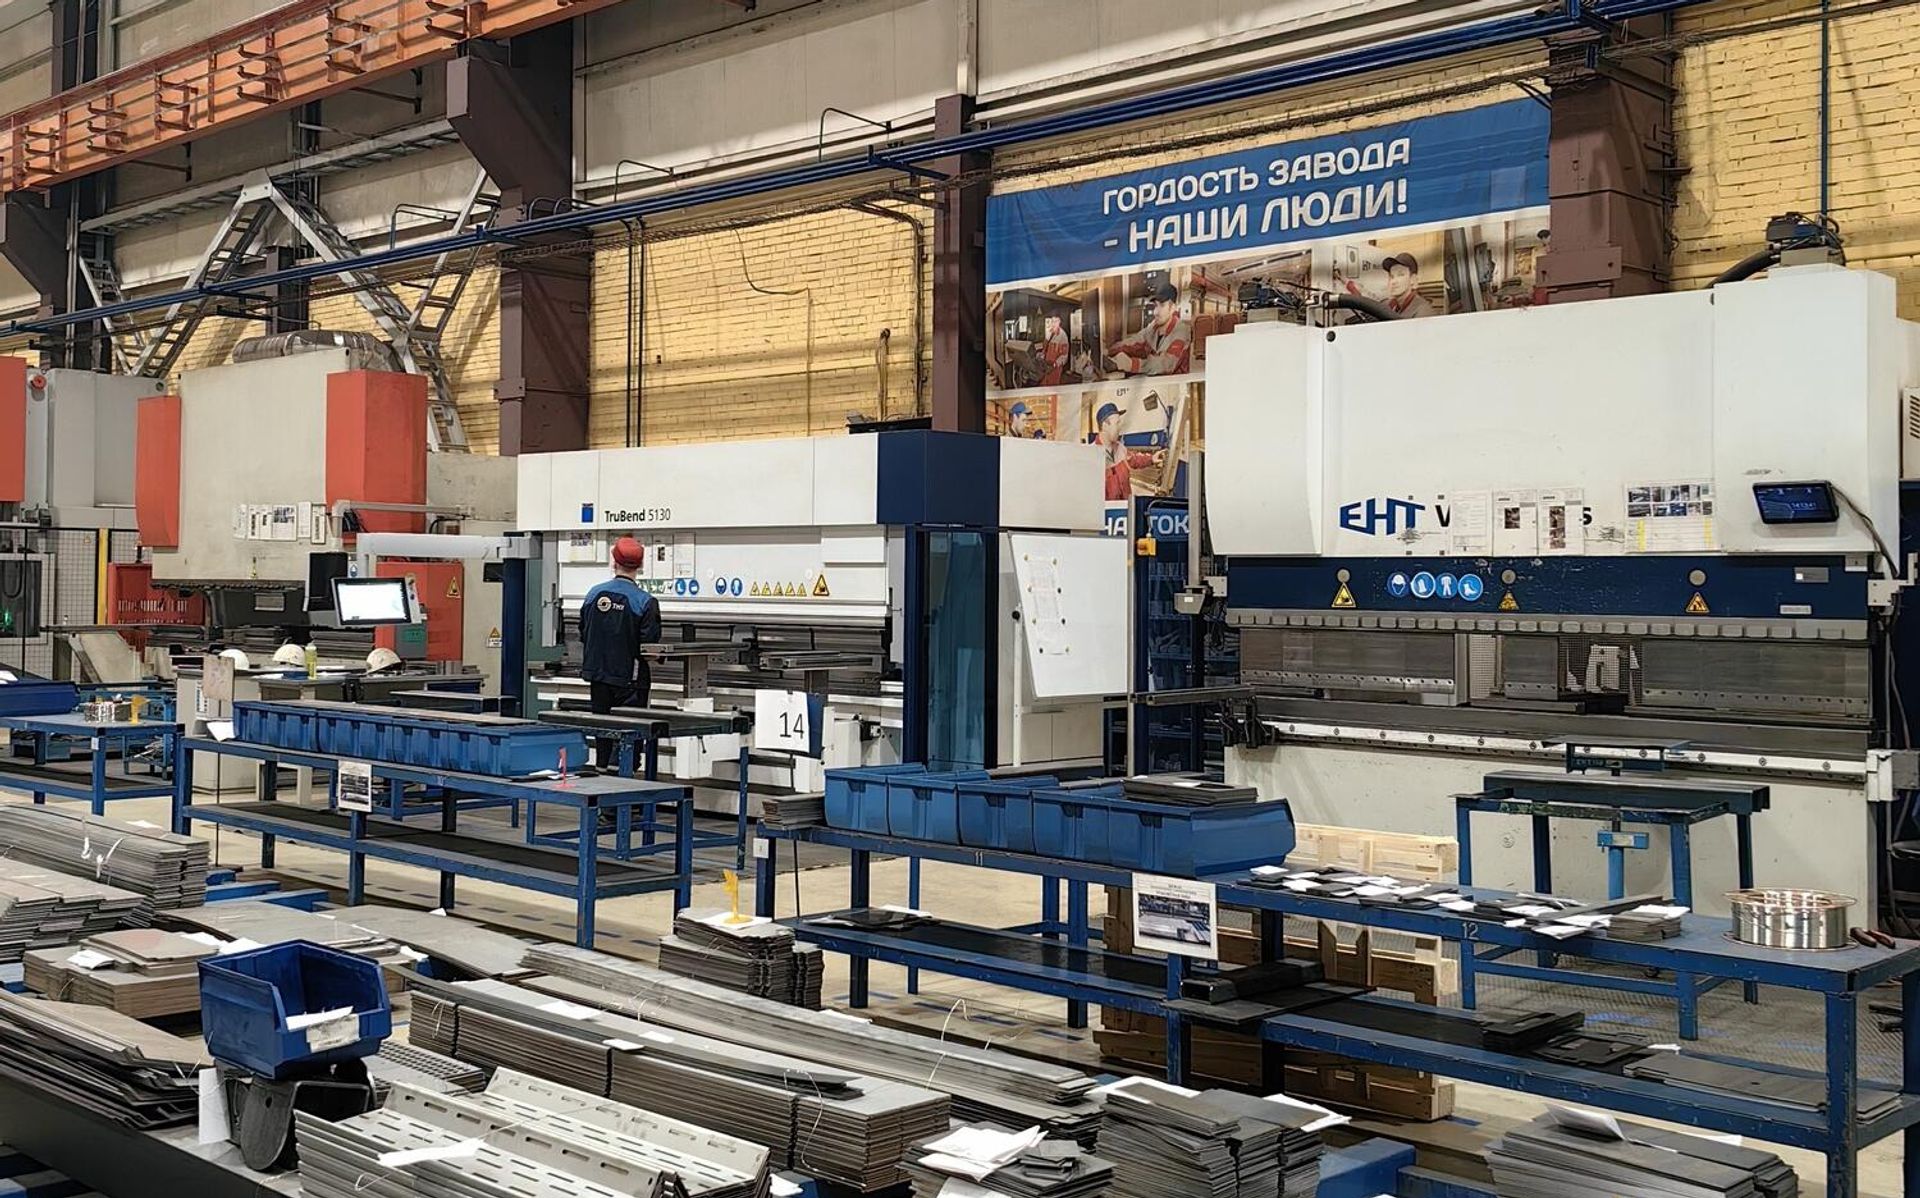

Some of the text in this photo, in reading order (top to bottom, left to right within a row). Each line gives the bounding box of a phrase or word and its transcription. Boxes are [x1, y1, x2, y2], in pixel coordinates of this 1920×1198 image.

[1103, 137, 1411, 214] ГОРДОСТЬ ЗАВОДА
[1104, 178, 1408, 252] - НАШИ ЛЮДИ!
[605, 508, 671, 522] TruBend 5130
[1339, 497, 1426, 536] EHT
[779, 711, 805, 739] 14
[1462, 922, 1479, 940] 12
